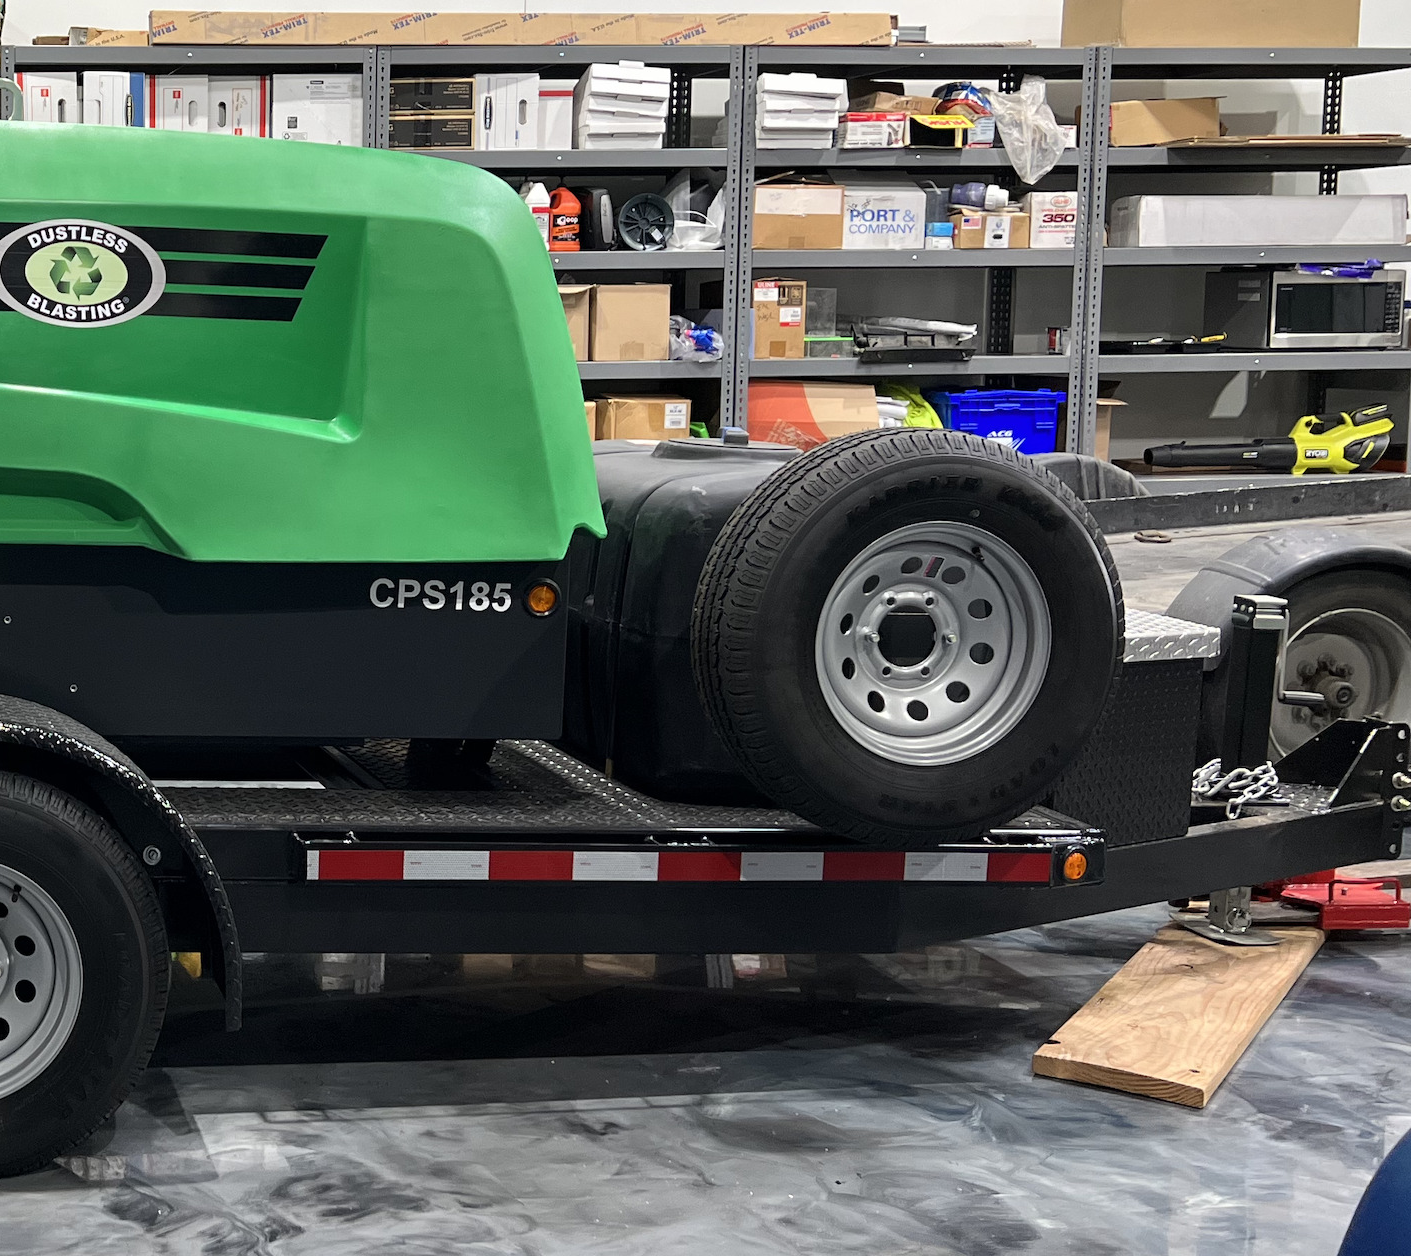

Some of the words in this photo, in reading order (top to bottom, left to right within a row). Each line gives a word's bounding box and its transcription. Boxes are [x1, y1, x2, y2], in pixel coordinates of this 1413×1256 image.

[262, 17, 308, 38] TRIM-TEX
[787, 17, 832, 39] TRIM-TEX
[850, 209, 900, 222] PORT
[903, 210, 915, 222] &
[1042, 213, 1075, 223] 350
[849, 223, 915, 234] COMPANY
[27, 226, 128, 253] DUSTLESS
[369, 577, 512, 612] CPS185
